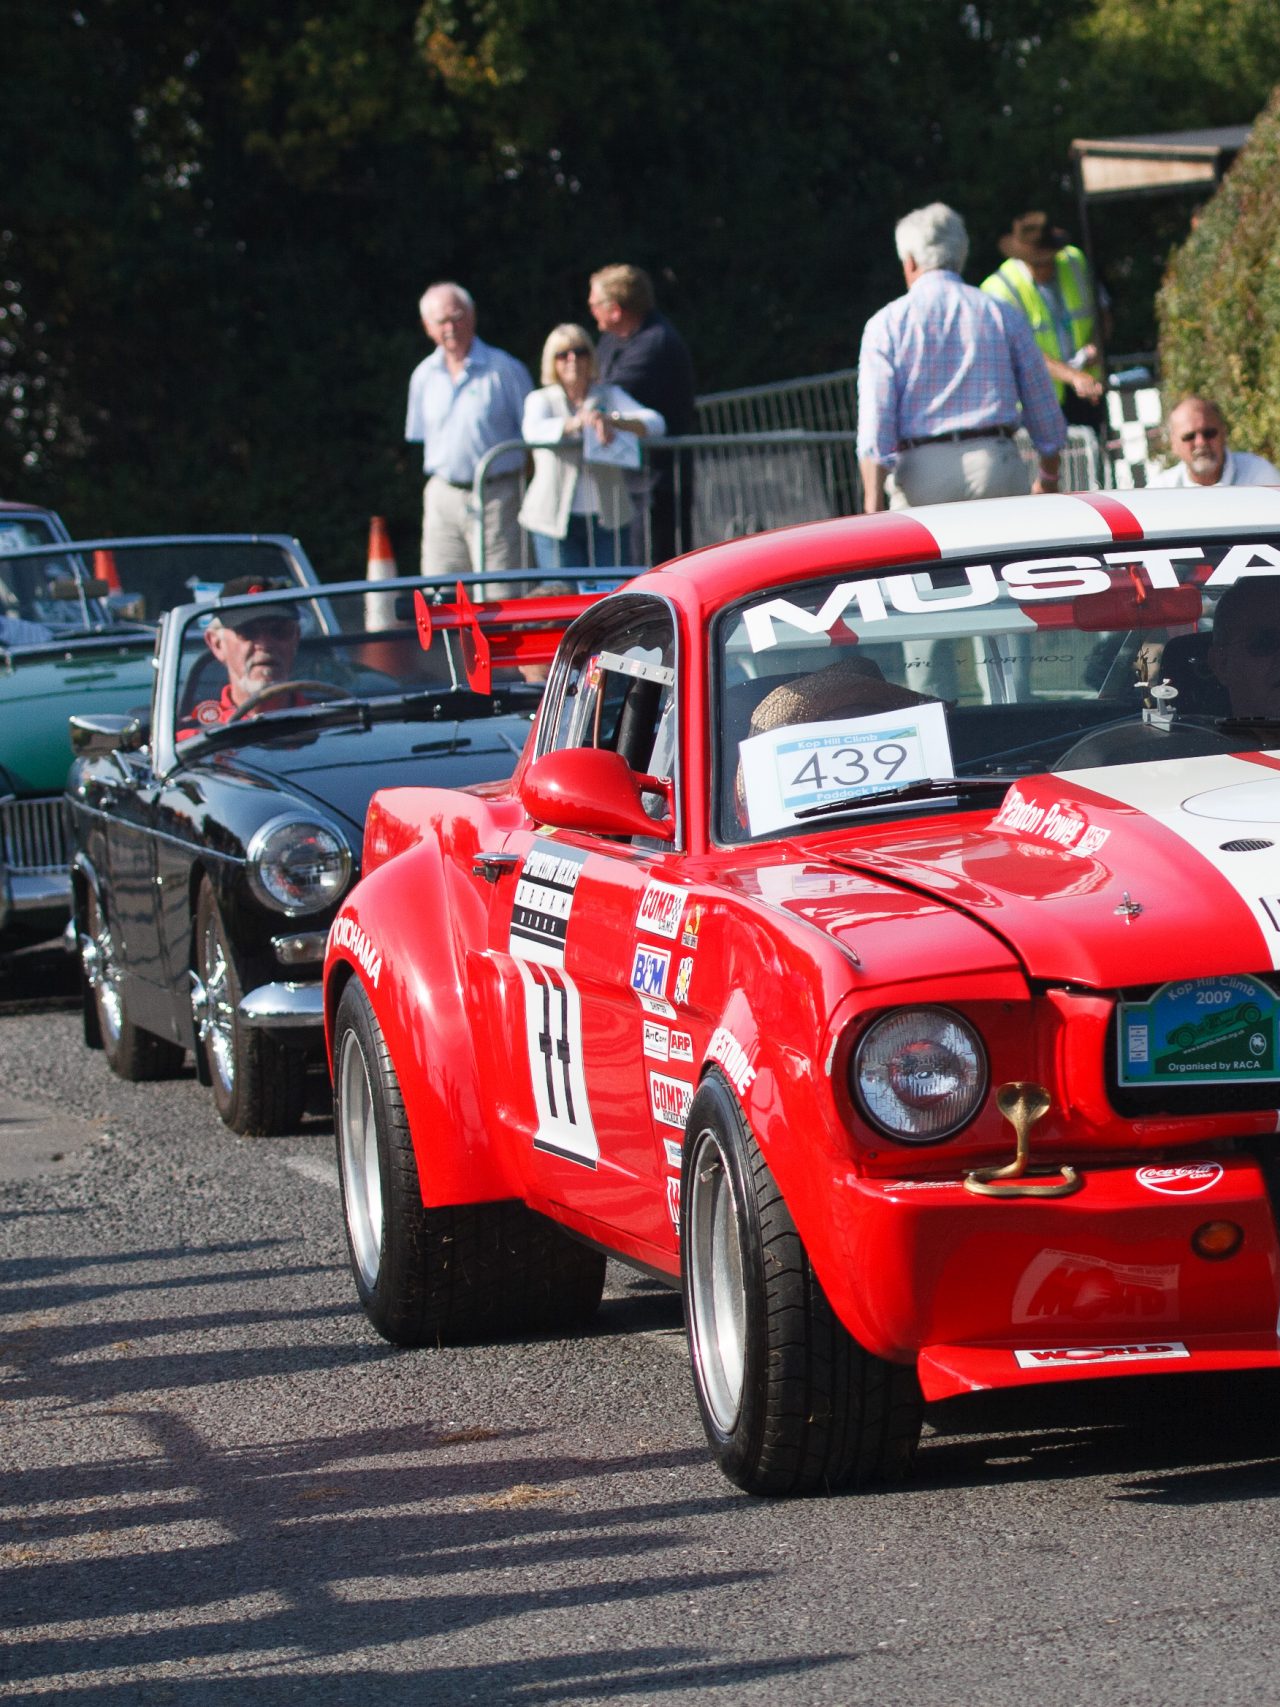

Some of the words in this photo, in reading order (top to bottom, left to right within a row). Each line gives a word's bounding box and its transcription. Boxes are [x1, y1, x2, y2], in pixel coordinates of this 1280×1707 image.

[798, 740, 821, 751] Kop
[824, 737, 841, 746] Hill
[844, 733, 878, 744] Climb
[791, 744, 908, 789] 439
[816, 787, 870, 801] Paddock
[997, 791, 1045, 833] Paxton
[1036, 803, 1085, 845] Power
[642, 888, 675, 921] COMP
[633, 953, 666, 996] B&M
[1167, 982, 1194, 1001] Kop
[1195, 976, 1217, 989] Hill
[1219, 976, 1257, 997] Climb
[1195, 990, 1232, 1005] 2009
[671, 1034, 691, 1052] ARP
[1168, 1061, 1217, 1073] Organised
[1219, 1061, 1231, 1073] by
[1233, 1060, 1261, 1070] RACA
[653, 1079, 683, 1115] COMP
[1029, 1345, 1174, 1361] WORLD
